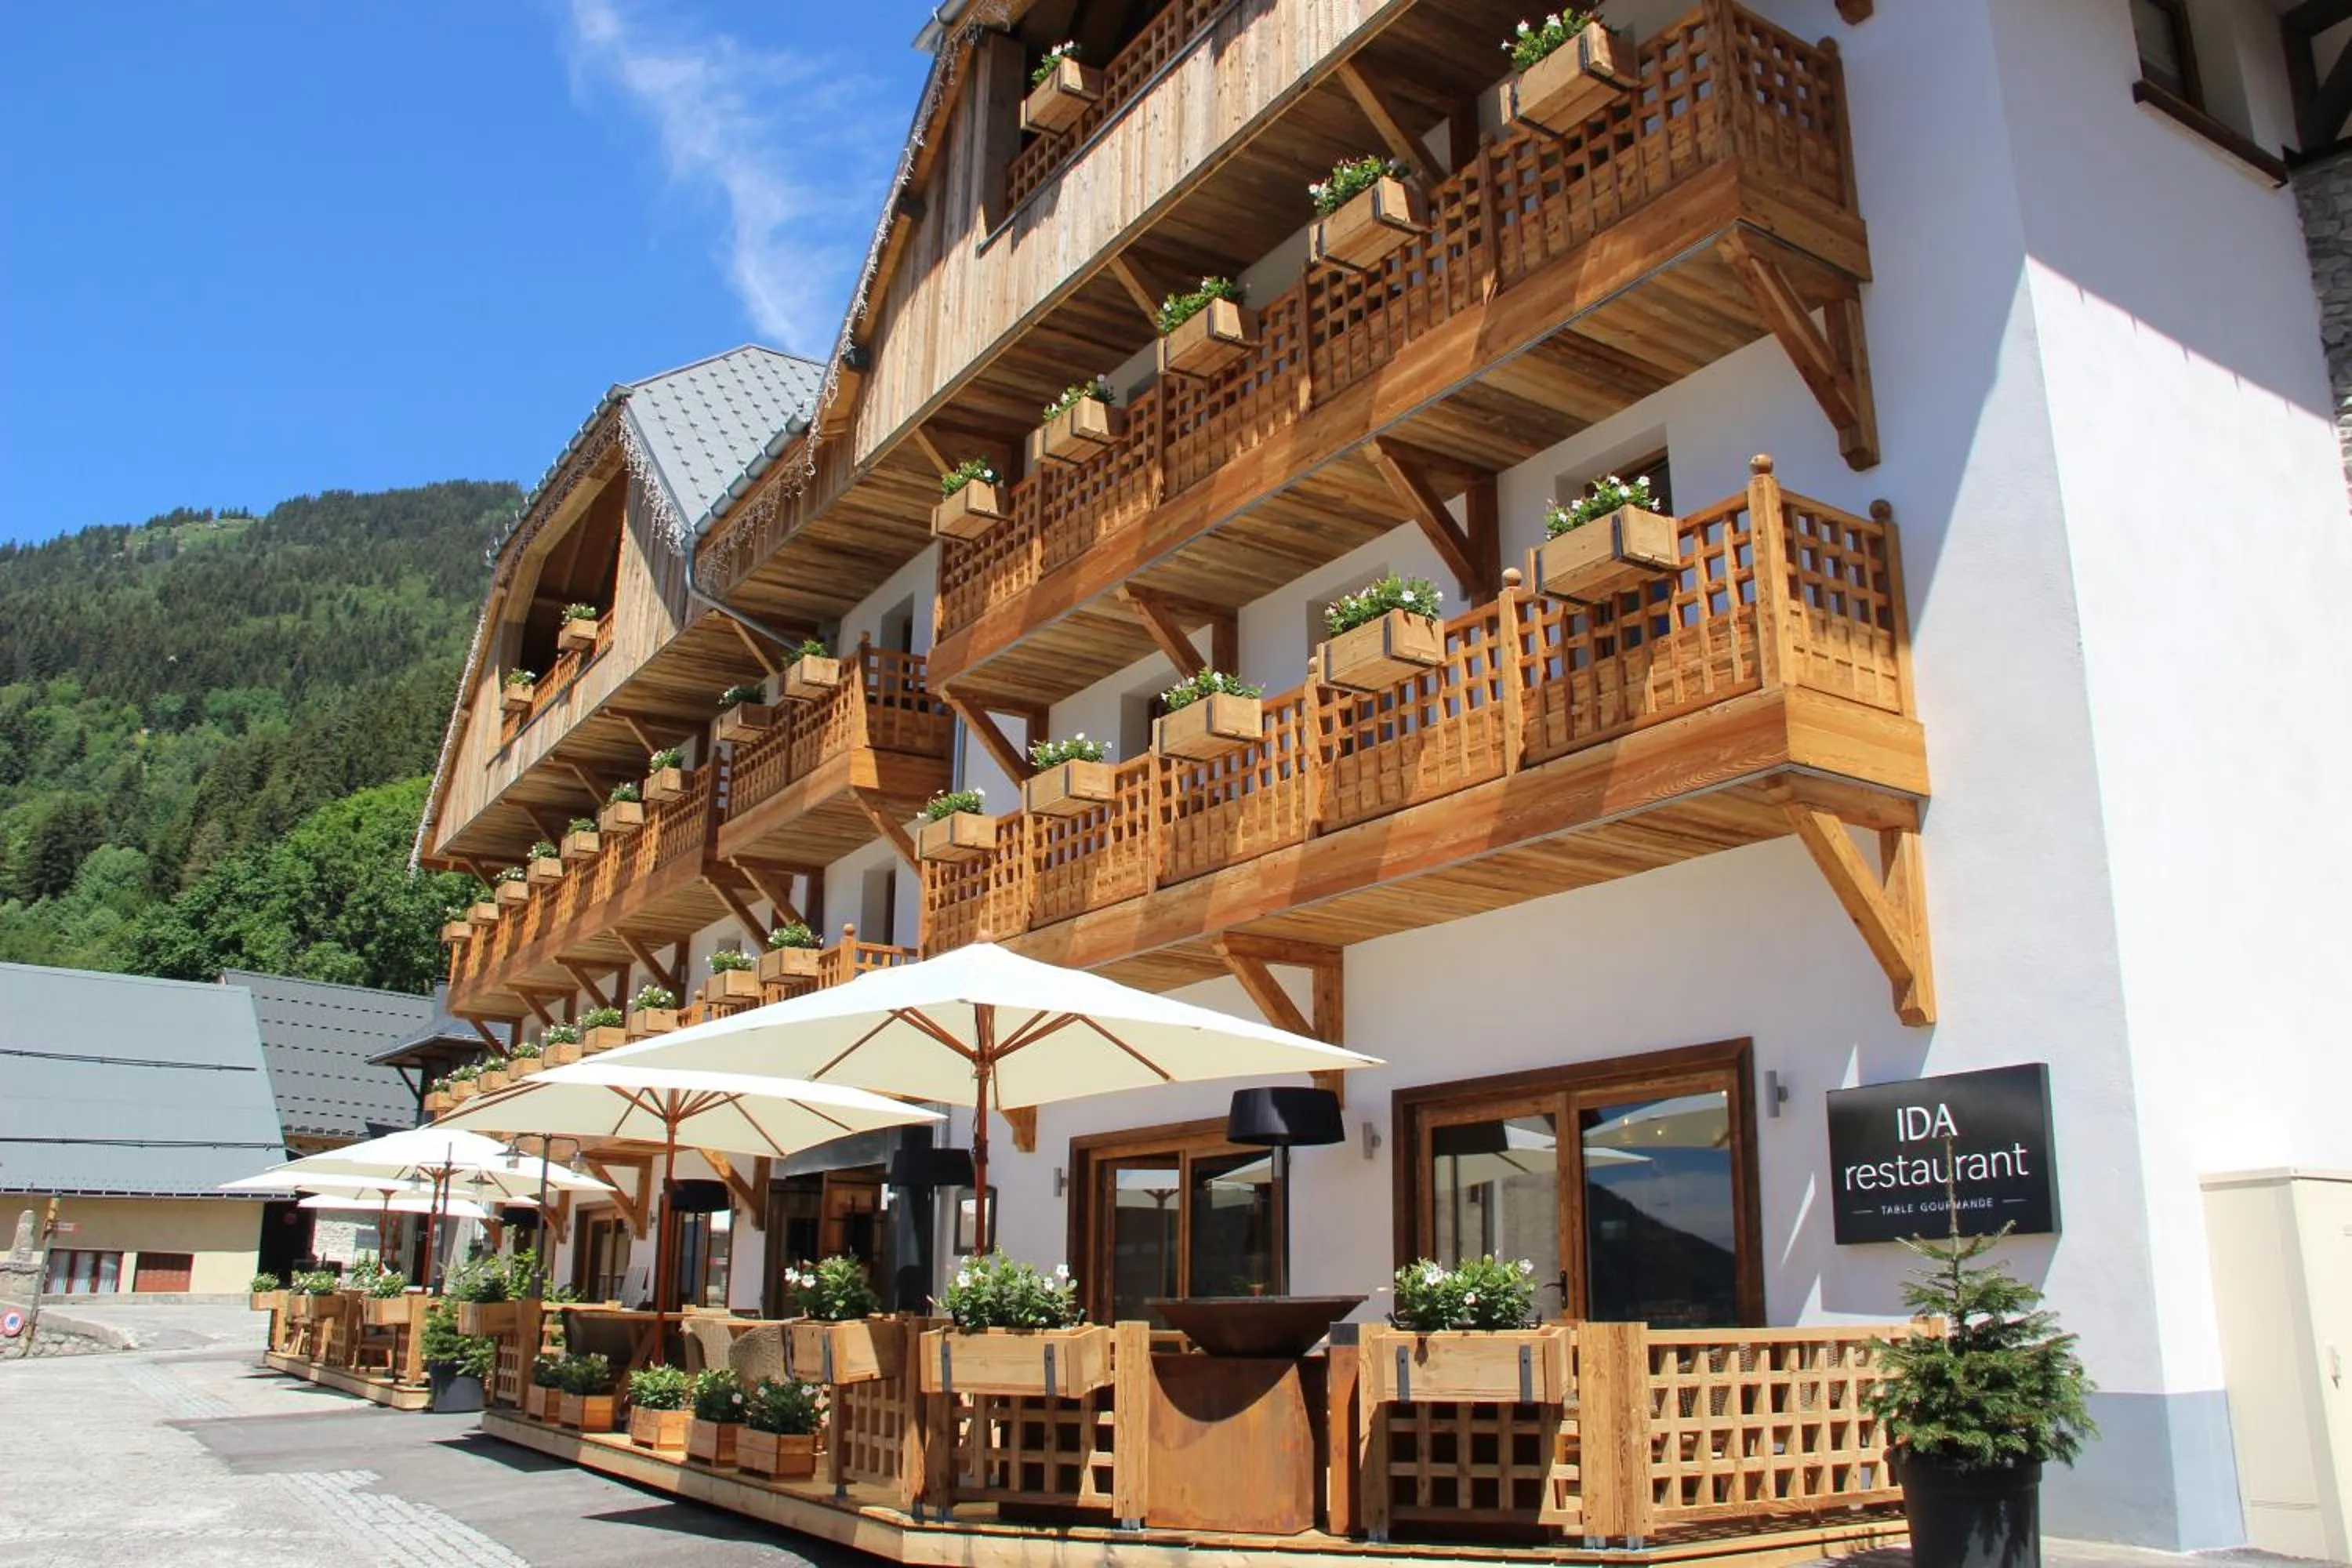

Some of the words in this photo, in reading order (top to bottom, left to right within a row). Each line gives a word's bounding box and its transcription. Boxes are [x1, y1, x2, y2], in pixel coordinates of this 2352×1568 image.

[1896, 1103, 1958, 1142] IDA
[1845, 1142, 2029, 1191] restaurant
[1882, 1203, 1914, 1215] TABLE
